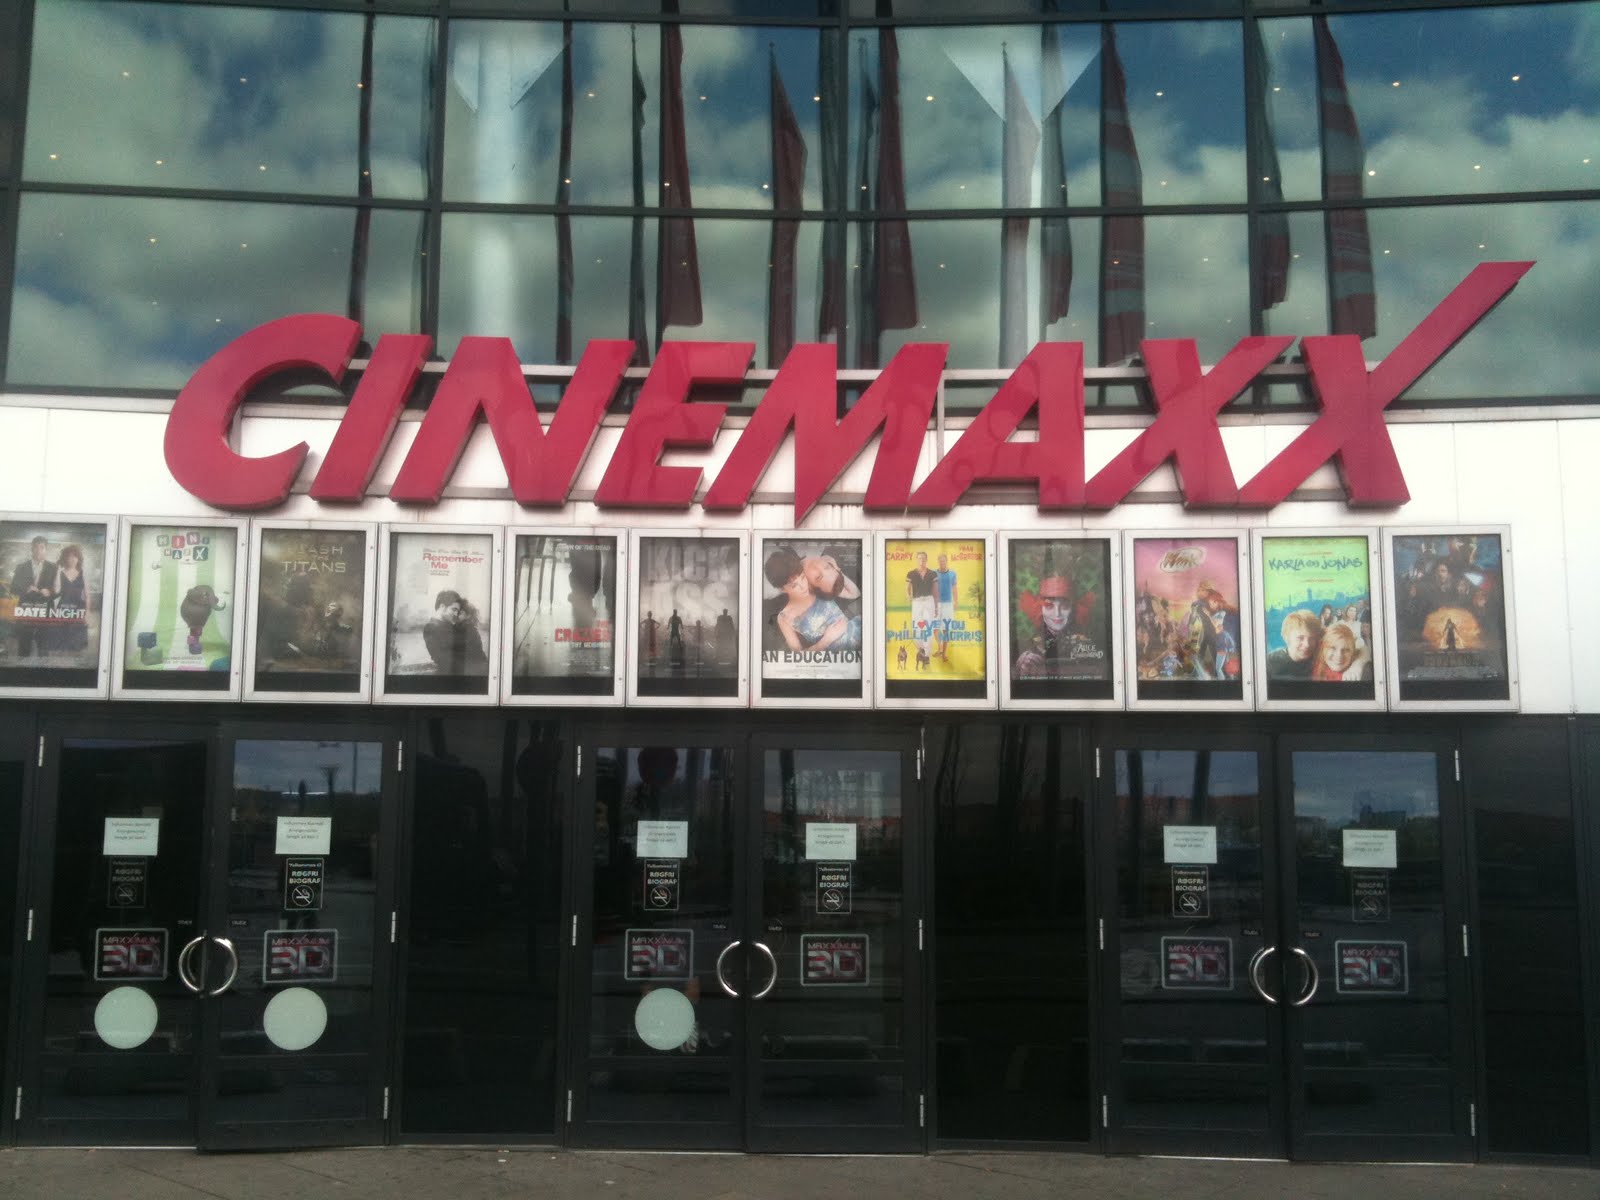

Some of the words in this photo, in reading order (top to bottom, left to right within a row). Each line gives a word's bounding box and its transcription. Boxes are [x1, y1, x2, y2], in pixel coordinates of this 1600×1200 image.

[164, 260, 1536, 528] CINEMAXX
[280, 561, 346, 573] TITANS
[423, 552, 484, 563] Remember
[431, 561, 449, 569] Me
[14, 607, 47, 618] DATE
[49, 608, 86, 619] NIGHT
[886, 630, 932, 642] PHILLIP
[762, 651, 778, 663] AN
[784, 651, 862, 663] EDUCATION
[102, 944, 160, 972] 3D
[271, 945, 330, 973] 3D
[631, 945, 686, 972] 3D
[807, 949, 863, 977] 3D
[1169, 952, 1225, 981] 3D
[1342, 957, 1402, 985] 3D
